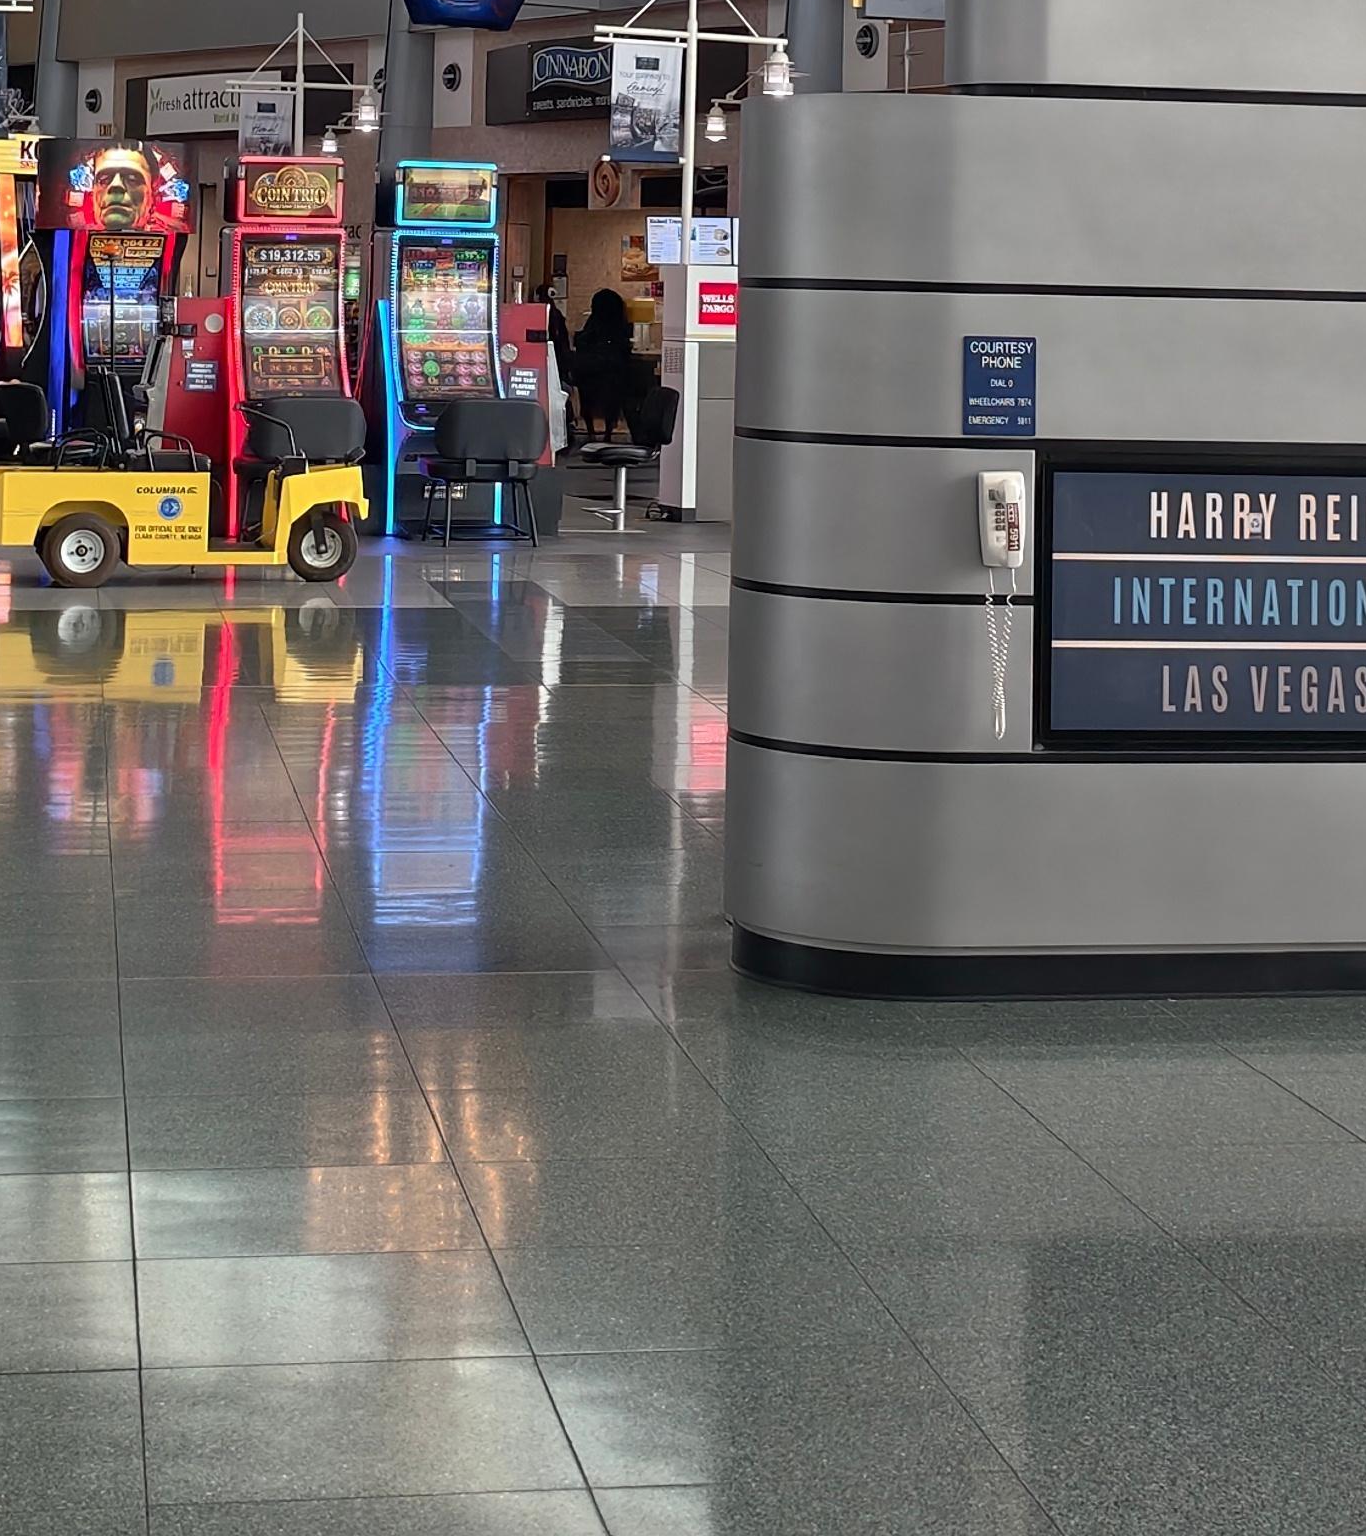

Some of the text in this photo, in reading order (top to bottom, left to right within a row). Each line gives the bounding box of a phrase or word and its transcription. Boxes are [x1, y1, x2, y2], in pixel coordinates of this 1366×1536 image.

[535, 47, 611, 80] CINNABON
[158, 97, 182, 112] fresh
[257, 186, 326, 205] COIN TRIO
[260, 249, 321, 262] $19,312.55
[701, 294, 734, 303] WELLS
[701, 304, 734, 314] FARGO
[970, 341, 1033, 354] COURTESY
[981, 356, 1022, 369] PHONE
[990, 378, 1007, 387] DIAL
[969, 397, 1015, 406] WHEELCHAIRS
[968, 416, 1009, 425] EMERGENCY
[136, 486, 186, 495] COLUMBIA
[1149, 490, 1277, 541] HARRY
[1009, 527, 1019, 550] 5911
[1162, 665, 1229, 713] LAS
